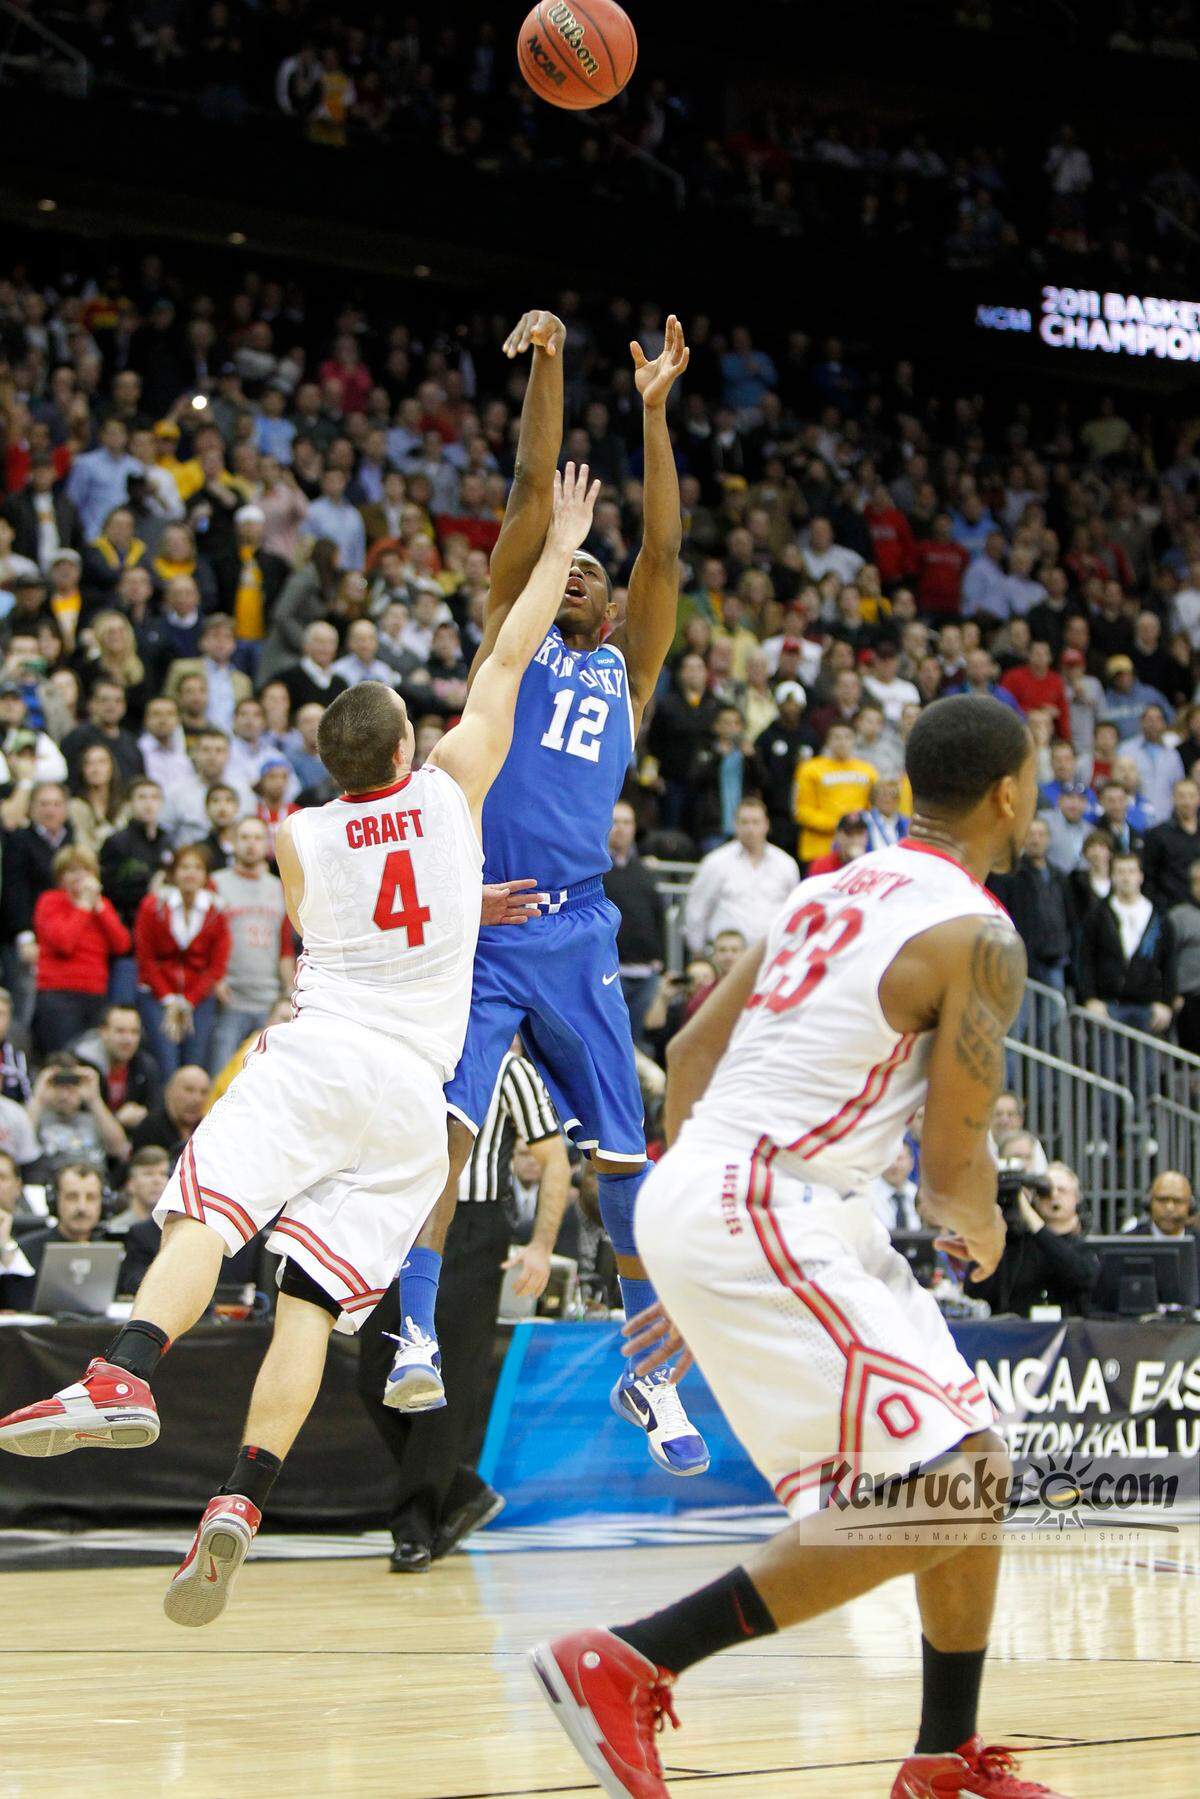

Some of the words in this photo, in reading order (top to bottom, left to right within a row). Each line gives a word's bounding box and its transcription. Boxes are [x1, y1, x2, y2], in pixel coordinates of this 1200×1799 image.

[527, 34, 567, 87] NCAA
[547, 0, 600, 78] Wilson
[1042, 285, 1100, 319] 2011
[1103, 292, 1200, 331] BASKE
[540, 688, 610, 763] 12
[345, 808, 424, 849] CRAFT
[372, 849, 432, 948] 4
[1080, 1418, 1169, 1460] HALL
